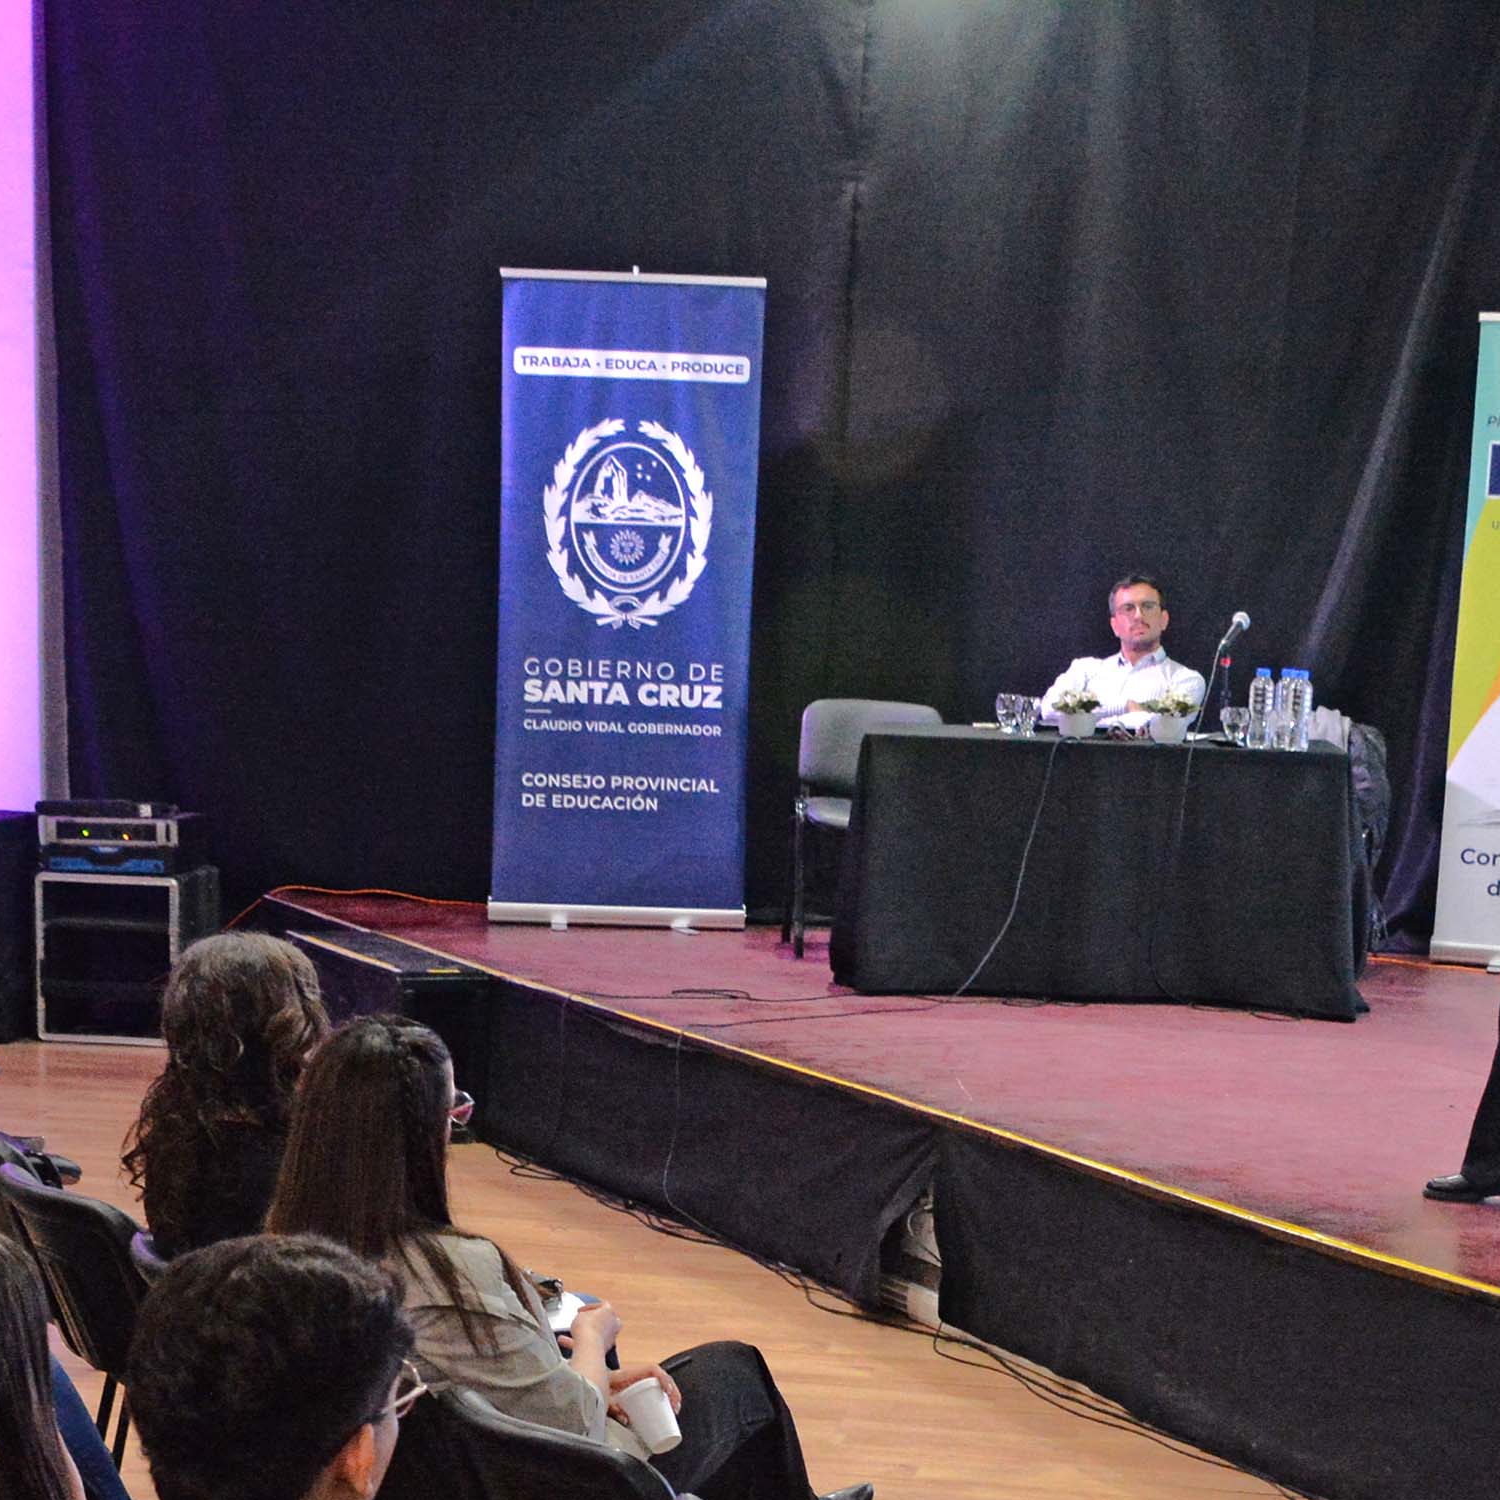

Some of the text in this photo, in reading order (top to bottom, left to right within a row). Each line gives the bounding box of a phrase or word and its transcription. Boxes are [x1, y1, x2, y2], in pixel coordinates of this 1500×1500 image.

[520, 354, 745, 376] TRABAJA EDUCA PRODUCE
[523, 657, 724, 682] GOBIERNO DE
[523, 678, 723, 709] SANTA CRUZ
[523, 719, 722, 737] CLAUDIO VIDAL GOBERNADOR
[521, 773, 720, 793] CONSEJO PROVINCIAL
[521, 792, 658, 811] DE EDUCACIÓN
